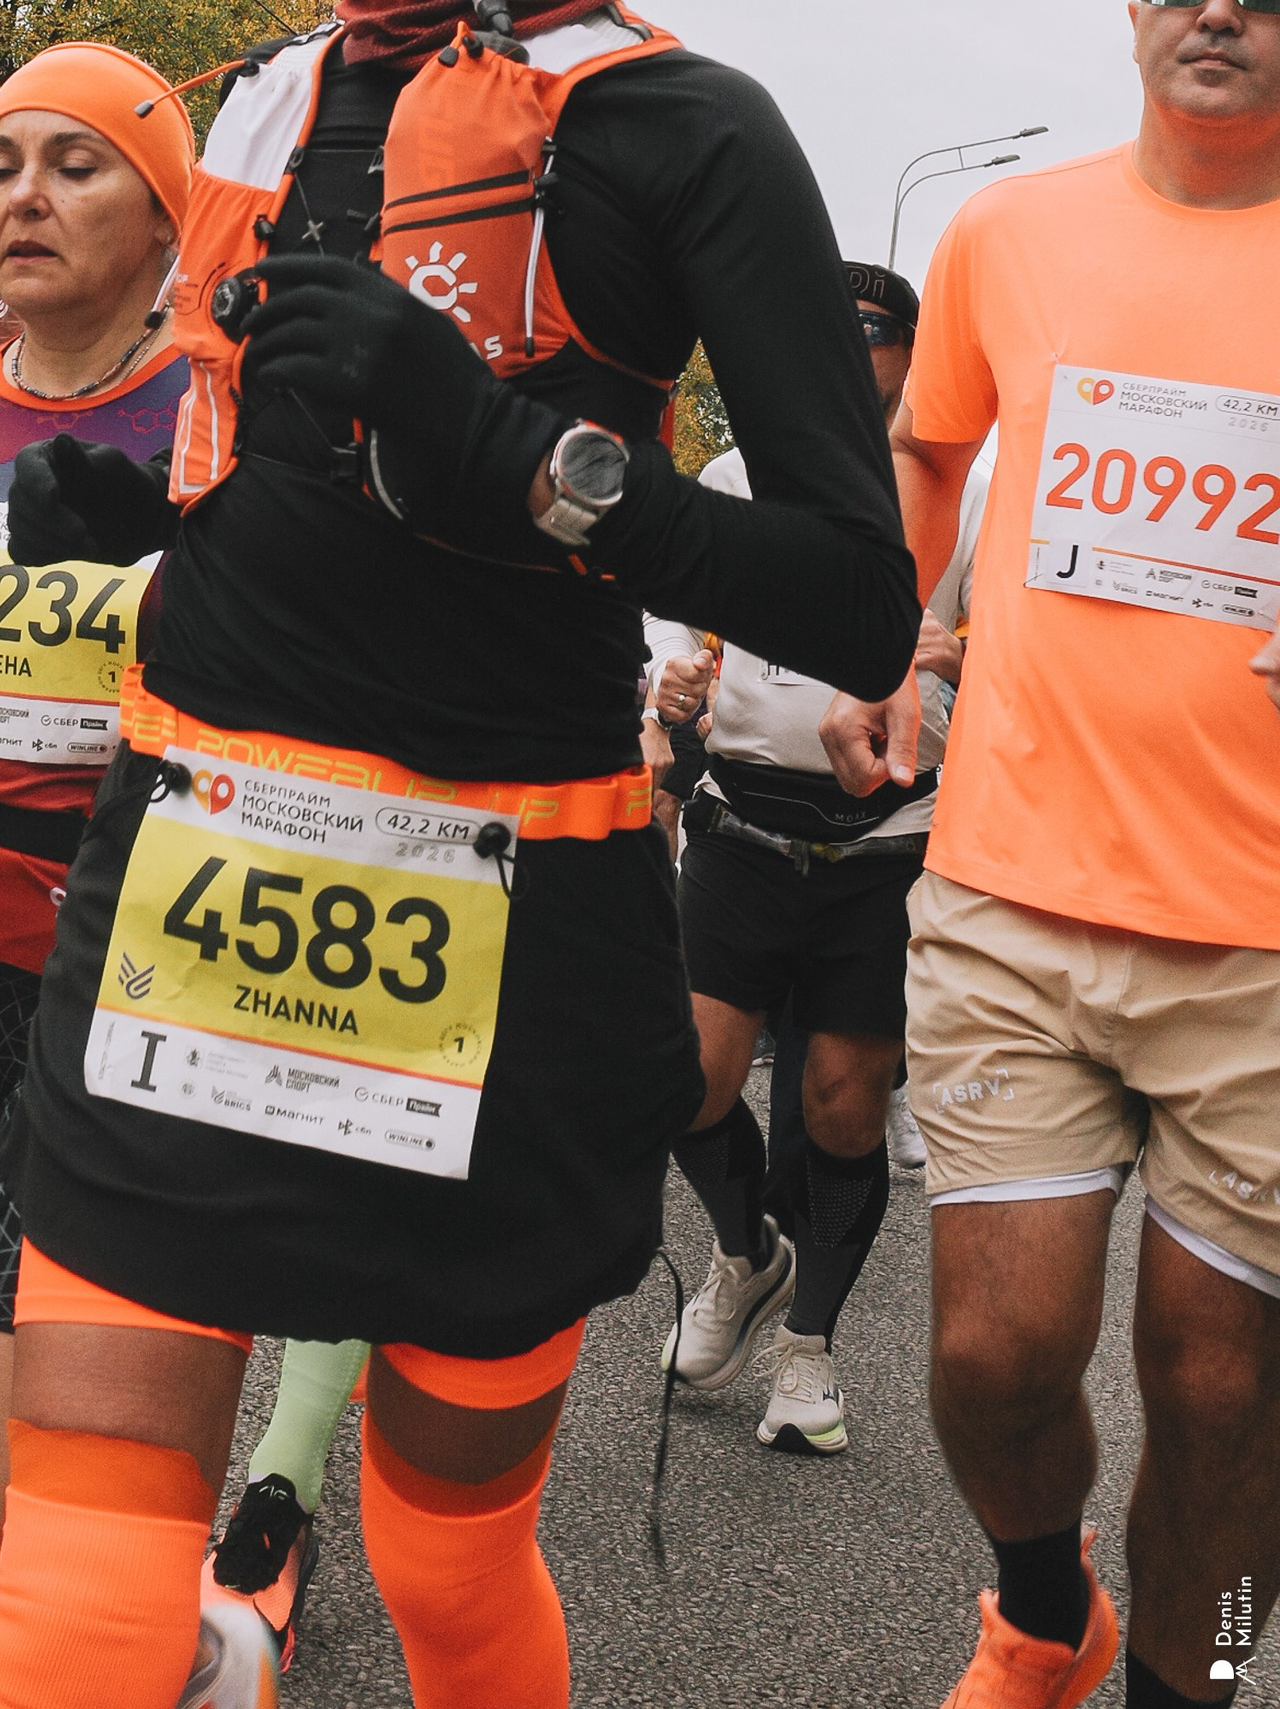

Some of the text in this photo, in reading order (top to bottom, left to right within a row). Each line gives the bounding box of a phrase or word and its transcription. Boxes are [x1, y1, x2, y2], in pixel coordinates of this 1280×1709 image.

[1122, 382, 1187, 397] СБЕРПРАЙМ
[1118, 401, 1183, 419] МАРАФОН
[1120, 391, 1208, 411] МОСКОВСКИЙ
[1223, 399, 1278, 417] 42,2 КМ
[1045, 442, 1280, 545] 20992
[1056, 544, 1079, 579] J
[108, 671, 116, 683] 1
[53, 719, 78, 727] СБЕР
[244, 779, 331, 808] СБЕРПРАЙМ
[242, 794, 363, 833] МОСКОВСКИЙ
[241, 812, 326, 843] МАРАФОН
[387, 814, 471, 840] 42,2 КМ
[395, 842, 456, 864] 2026
[163, 855, 451, 1005] 4583
[233, 984, 359, 1036] ZHANNA
[453, 1036, 465, 1054] 1
[130, 1030, 167, 1093] I
[285, 1080, 310, 1094] СПОРТ
[287, 1068, 340, 1087] МОСКОВСКИЙ
[371, 1091, 404, 1107] СБЕР
[941, 1078, 1000, 1106] ASRV
[388, 1133, 424, 1147] WINLINE
